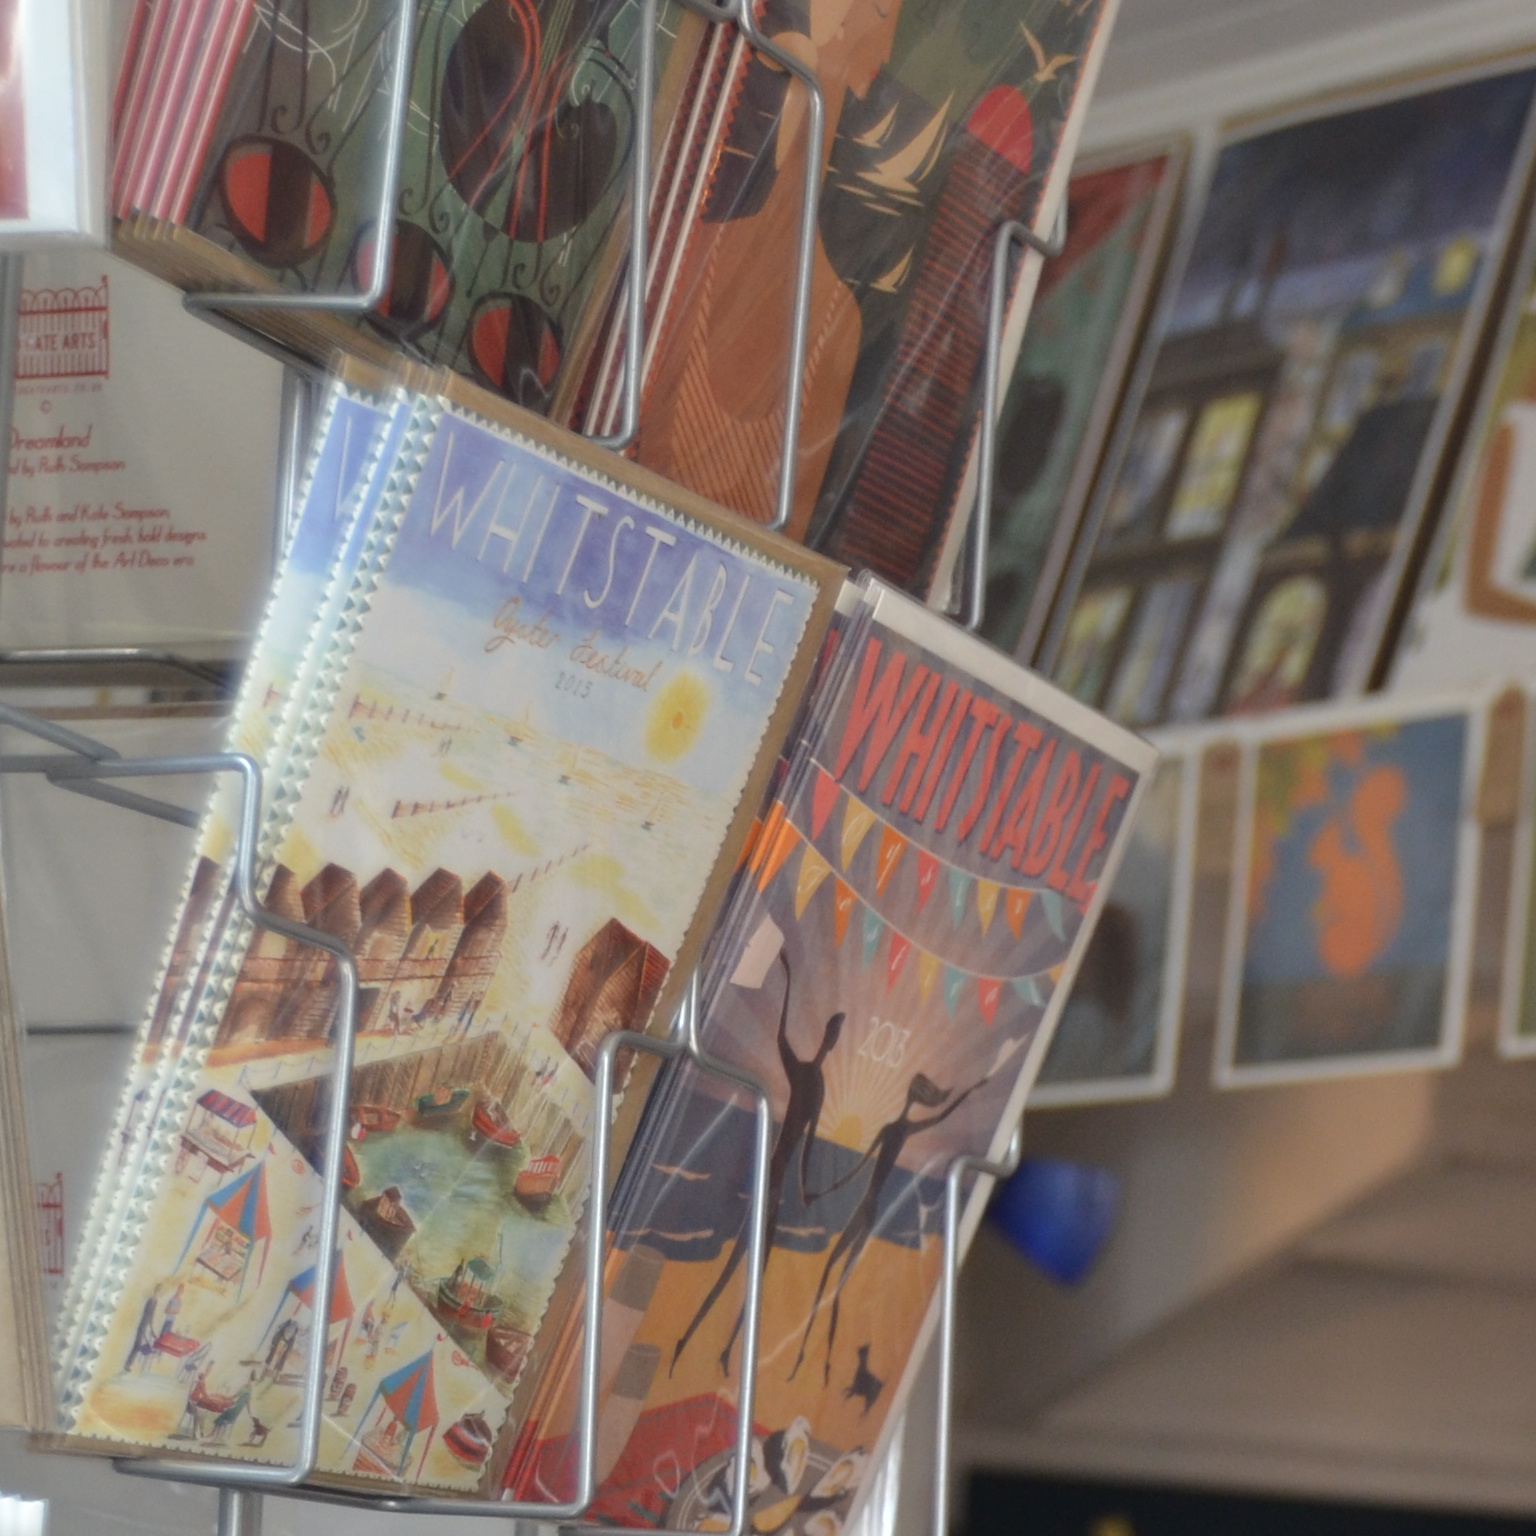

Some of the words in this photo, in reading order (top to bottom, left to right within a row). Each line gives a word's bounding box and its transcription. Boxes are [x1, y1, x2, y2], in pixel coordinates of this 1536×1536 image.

[62, 331, 96, 350] ARTS
[430, 431, 795, 687] WHITSTABLE
[483, 595, 563, 653] Oyster
[568, 628, 664, 692] Festival
[554, 670, 593, 699] 2015
[833, 636, 1130, 902] WHITSTABLE
